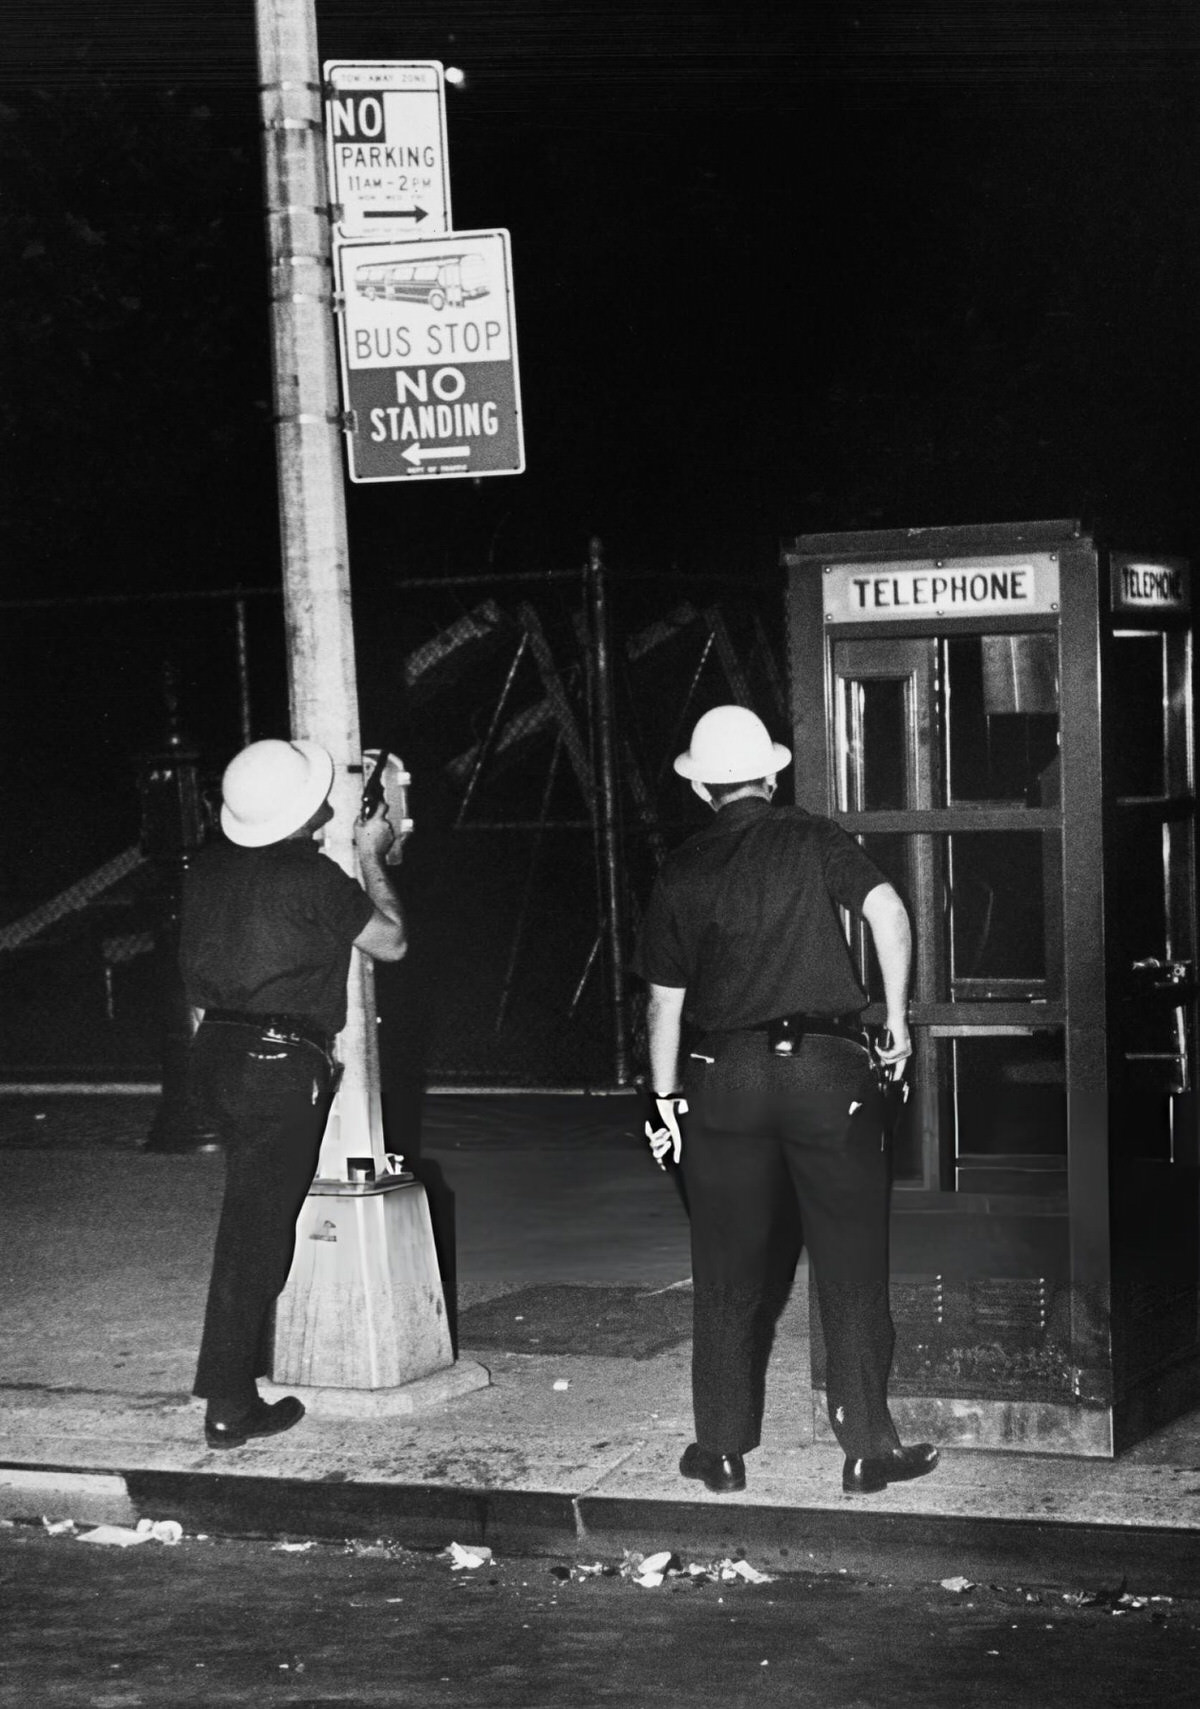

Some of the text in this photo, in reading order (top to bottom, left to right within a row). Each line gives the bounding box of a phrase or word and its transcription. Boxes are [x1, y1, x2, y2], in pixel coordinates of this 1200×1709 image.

[333, 97, 383, 137] NO
[341, 146, 435, 168] PARKING
[355, 321, 501, 359] BUS STOP
[395, 367, 466, 403] NO
[370, 401, 498, 442] STANDING
[852, 570, 1027, 608] TELEPHONE
